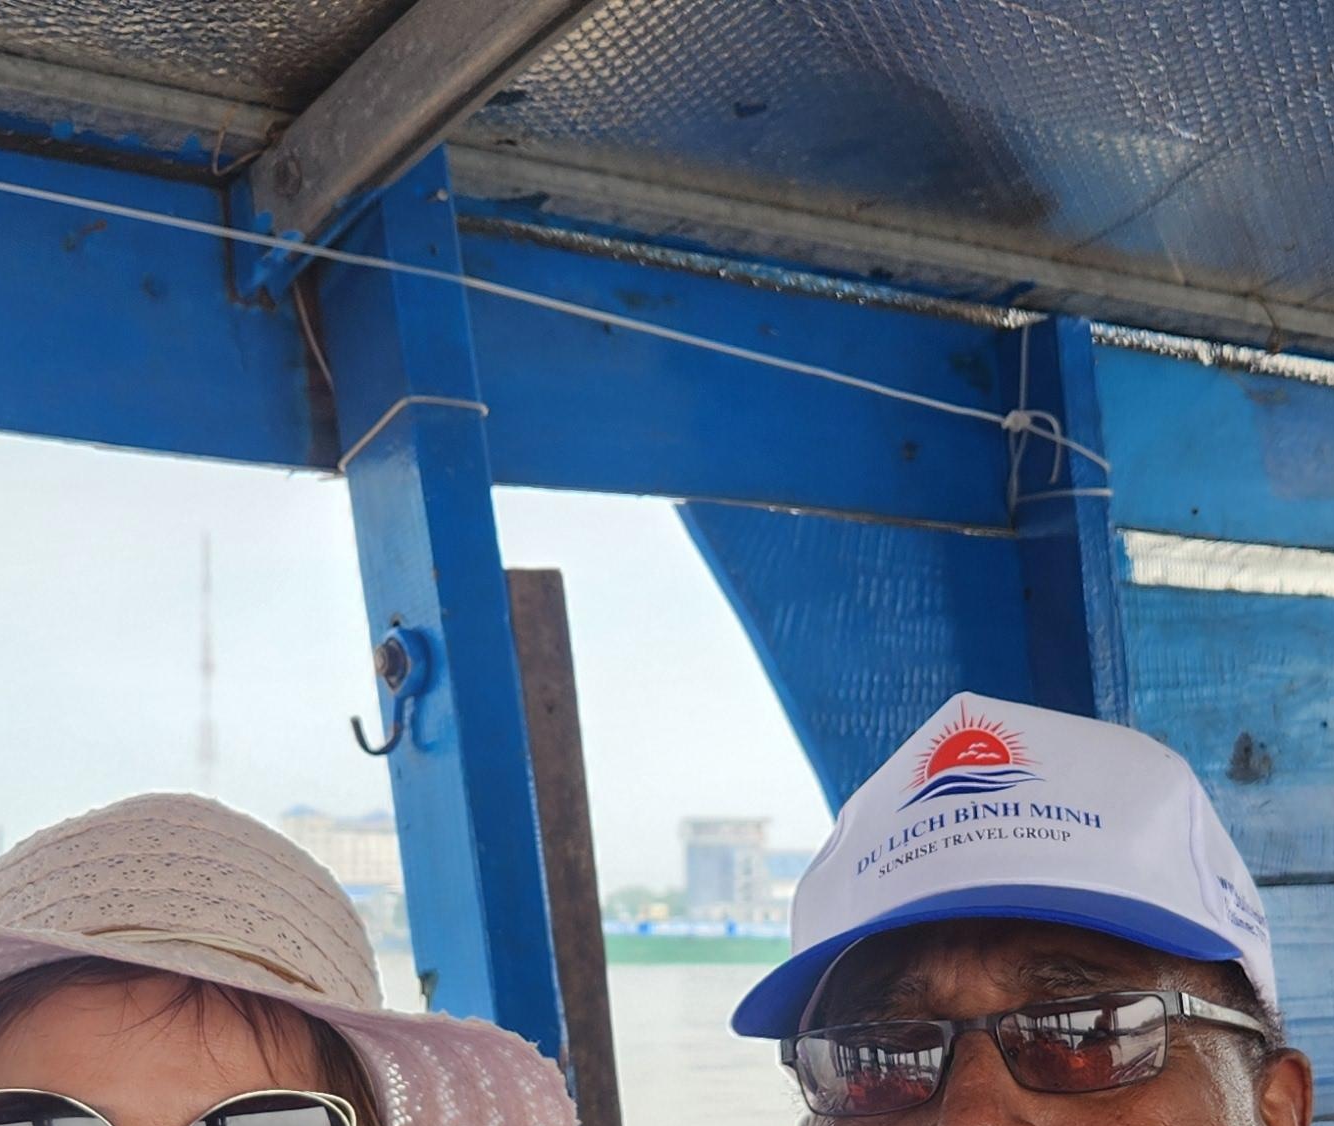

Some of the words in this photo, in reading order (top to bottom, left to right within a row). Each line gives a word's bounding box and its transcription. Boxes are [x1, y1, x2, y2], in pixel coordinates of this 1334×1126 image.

[856, 845, 883, 876] DU
[887, 812, 946, 853] LỊCH
[953, 800, 1021, 824] BÌNH
[1029, 802, 1104, 829] MINH
[878, 840, 939, 879] SUNRISE
[941, 826, 1009, 849] TRAVEL
[1013, 826, 1072, 843] GROUP
